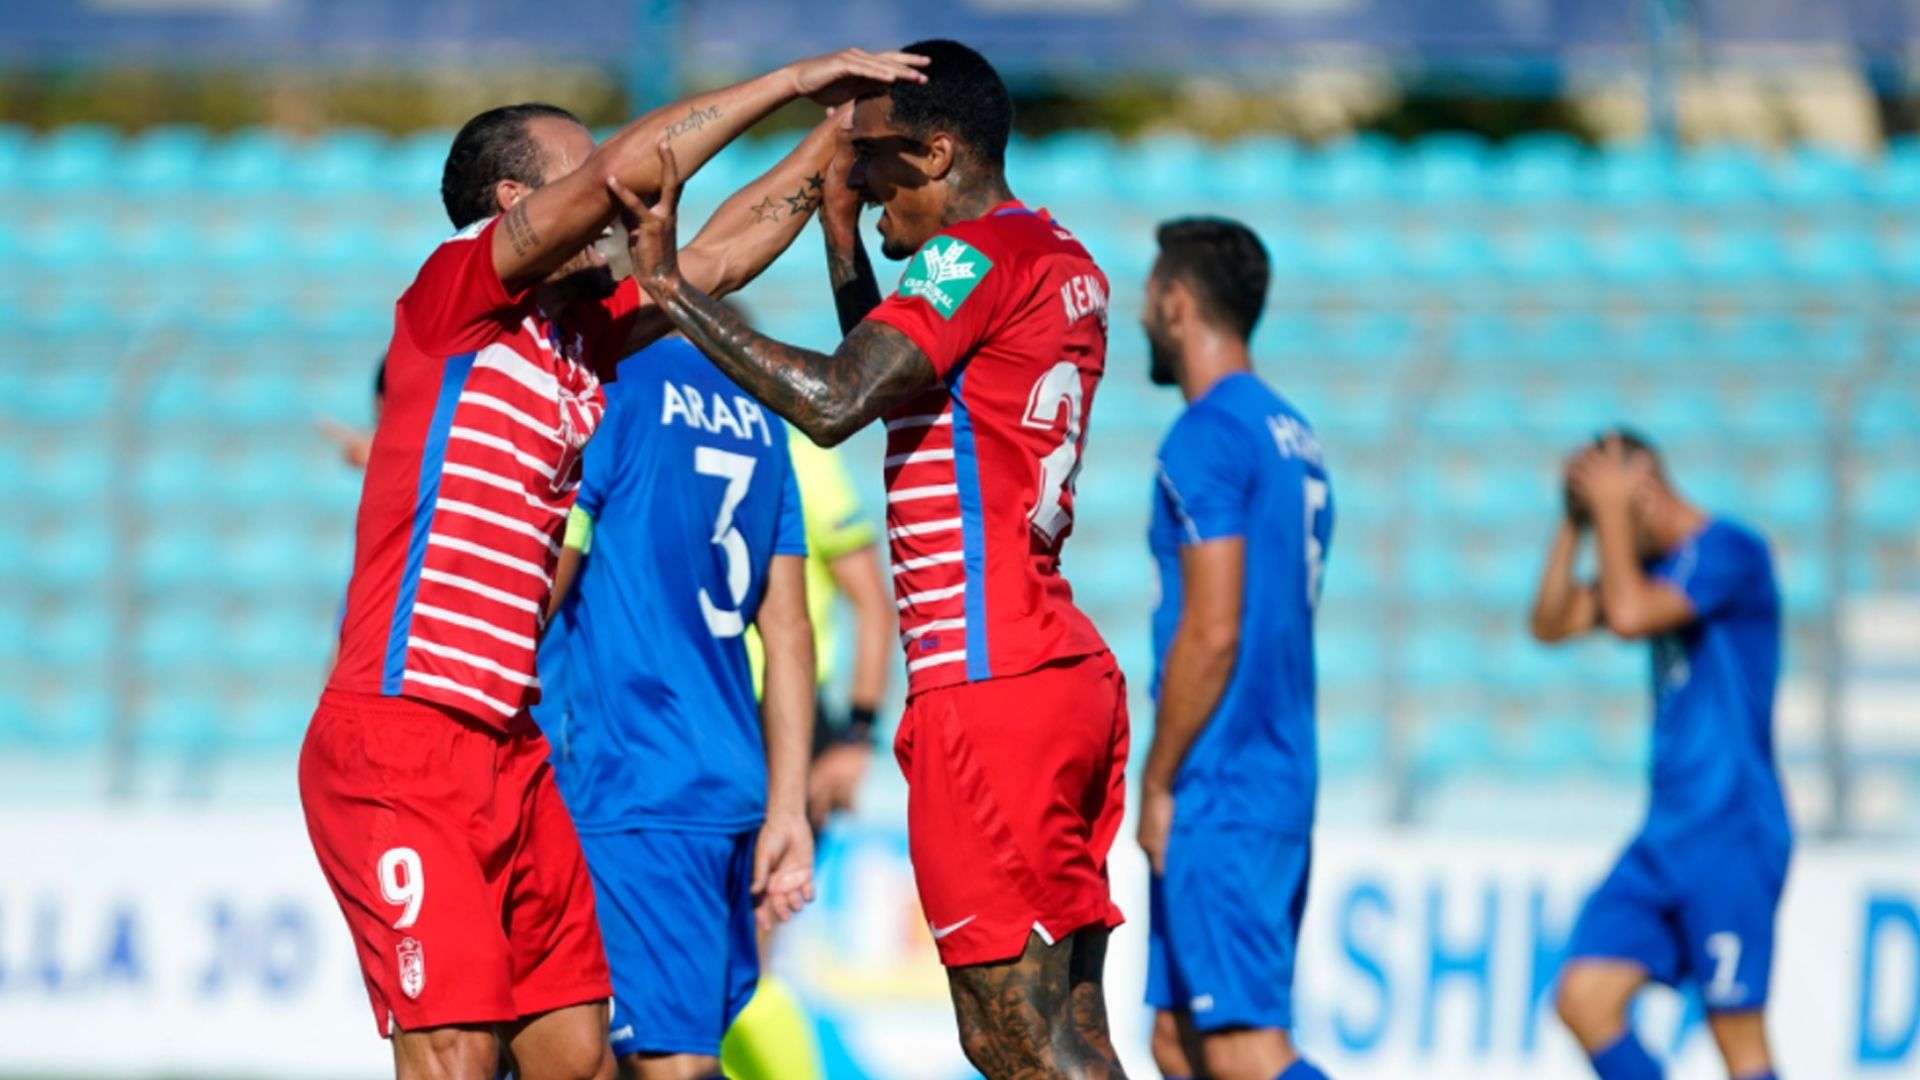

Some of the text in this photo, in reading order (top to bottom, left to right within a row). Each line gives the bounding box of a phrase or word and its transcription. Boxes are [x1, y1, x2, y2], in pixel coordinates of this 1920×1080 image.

[661, 380, 772, 446] ARAPI
[1021, 361, 1083, 546] 2
[694, 446, 757, 637] 3
[378, 847, 425, 929] 9
